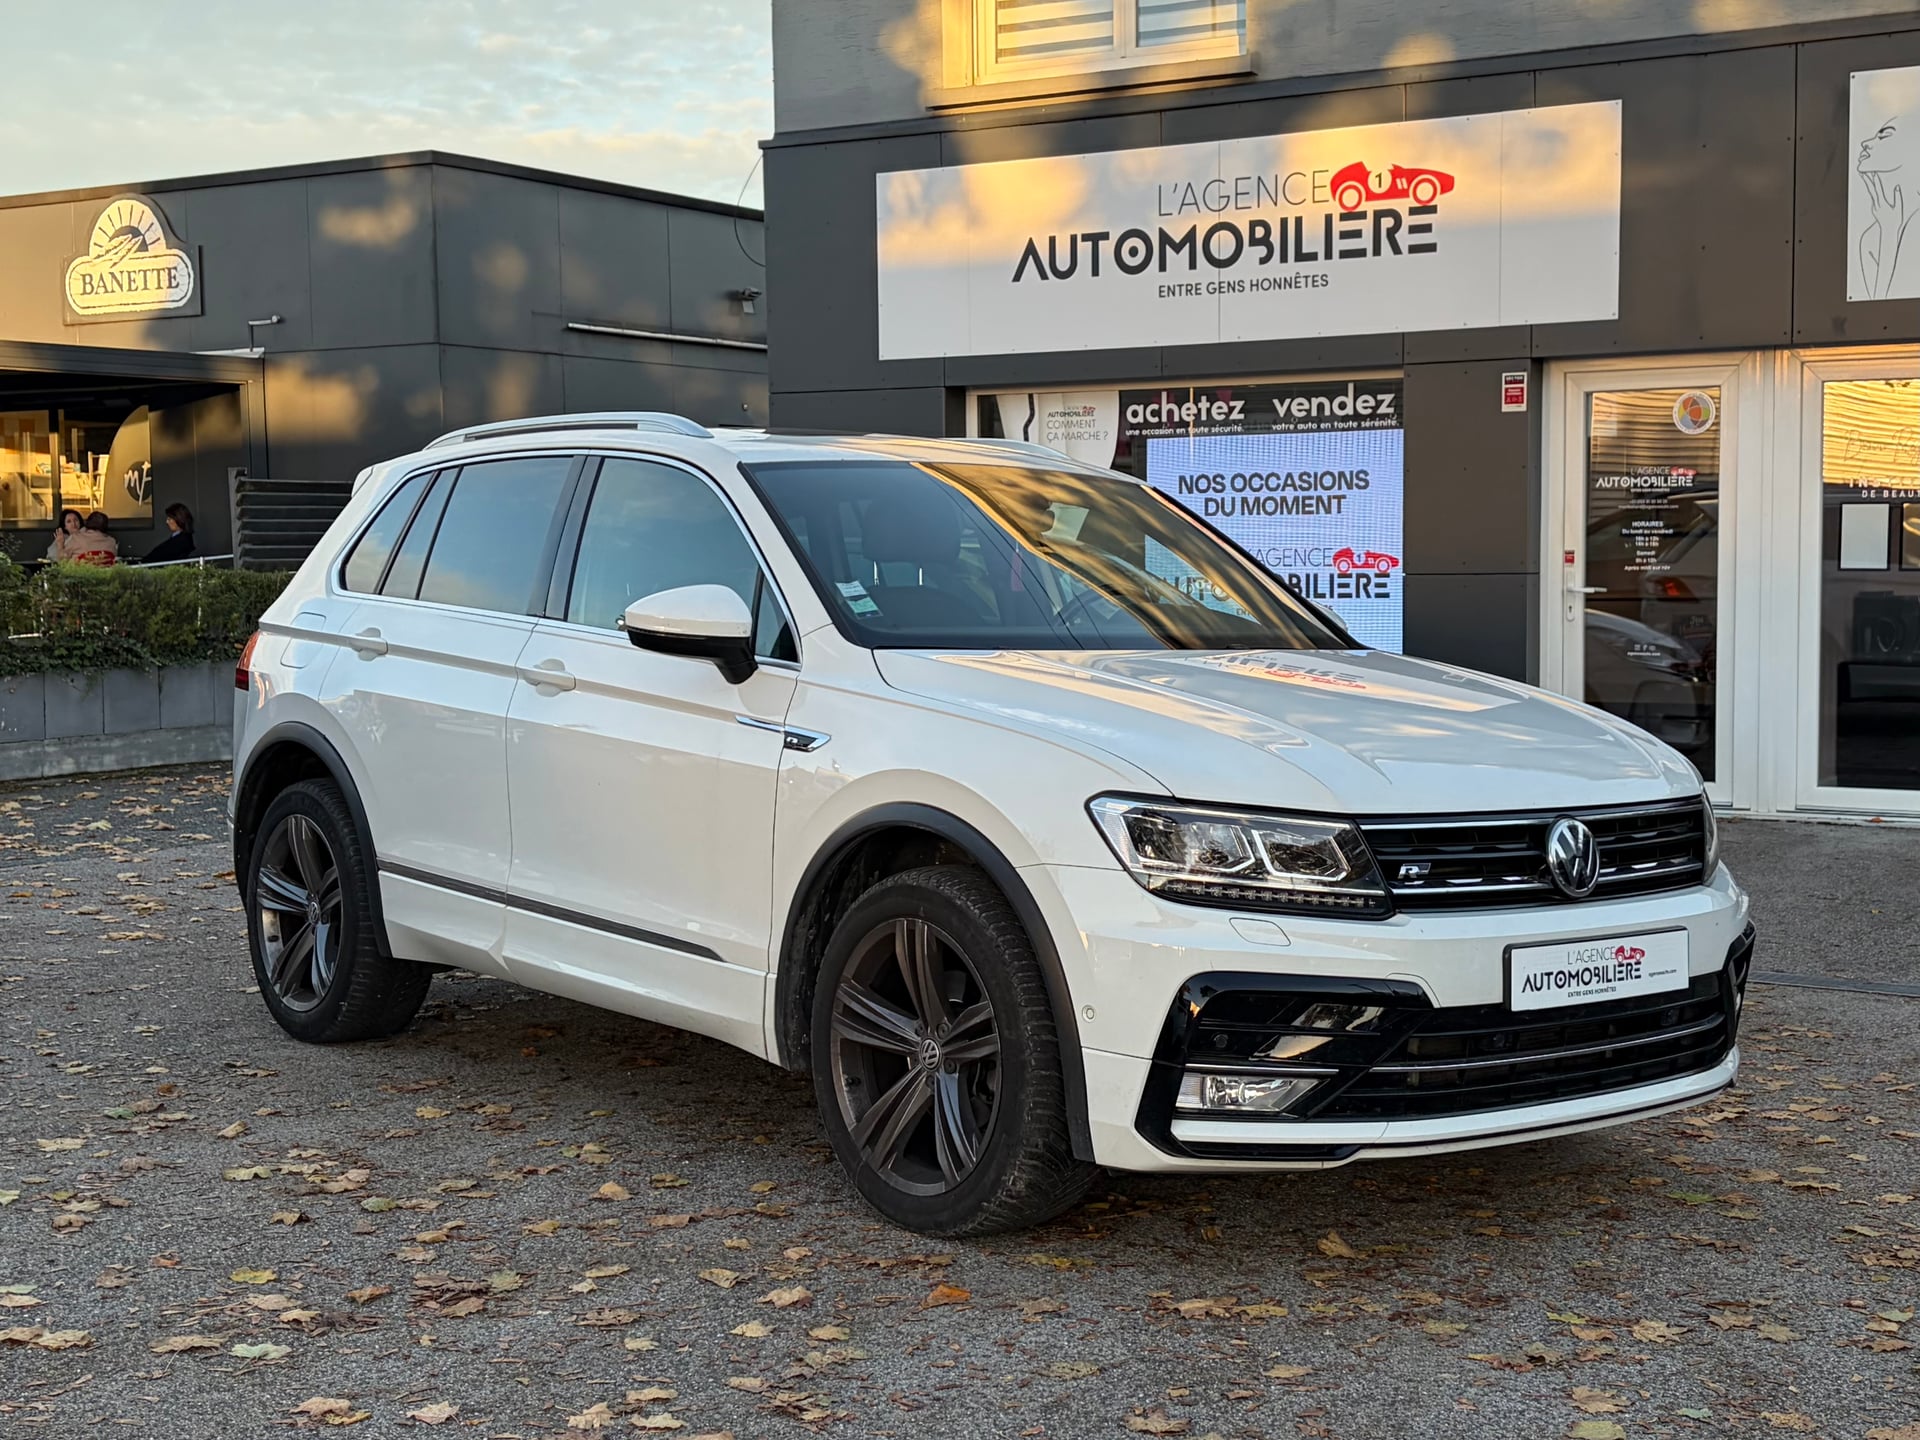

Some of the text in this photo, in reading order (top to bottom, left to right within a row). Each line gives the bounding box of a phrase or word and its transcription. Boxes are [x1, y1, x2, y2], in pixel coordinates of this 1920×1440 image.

[1158, 168, 1330, 217] L'AGENCE
[79, 266, 180, 296] BANETTE
[1158, 271, 1330, 298] ENTRE GENS HONNÊTES
[1125, 382, 1396, 424] achetez vendez
[1046, 419, 1097, 430] COMMENT
[1061, 431, 1101, 441] MARCHE
[1125, 428, 1140, 436] une
[1142, 427, 1174, 436] occasion
[1272, 422, 1295, 431] votre
[1297, 420, 1318, 430] auto
[1320, 422, 1331, 430] en
[1334, 420, 1358, 429] toute
[1178, 469, 1370, 495] NOS OCCASIONS
[1204, 494, 1347, 517] DU MOMENT
[1567, 945, 1616, 965] L'AGENCE
